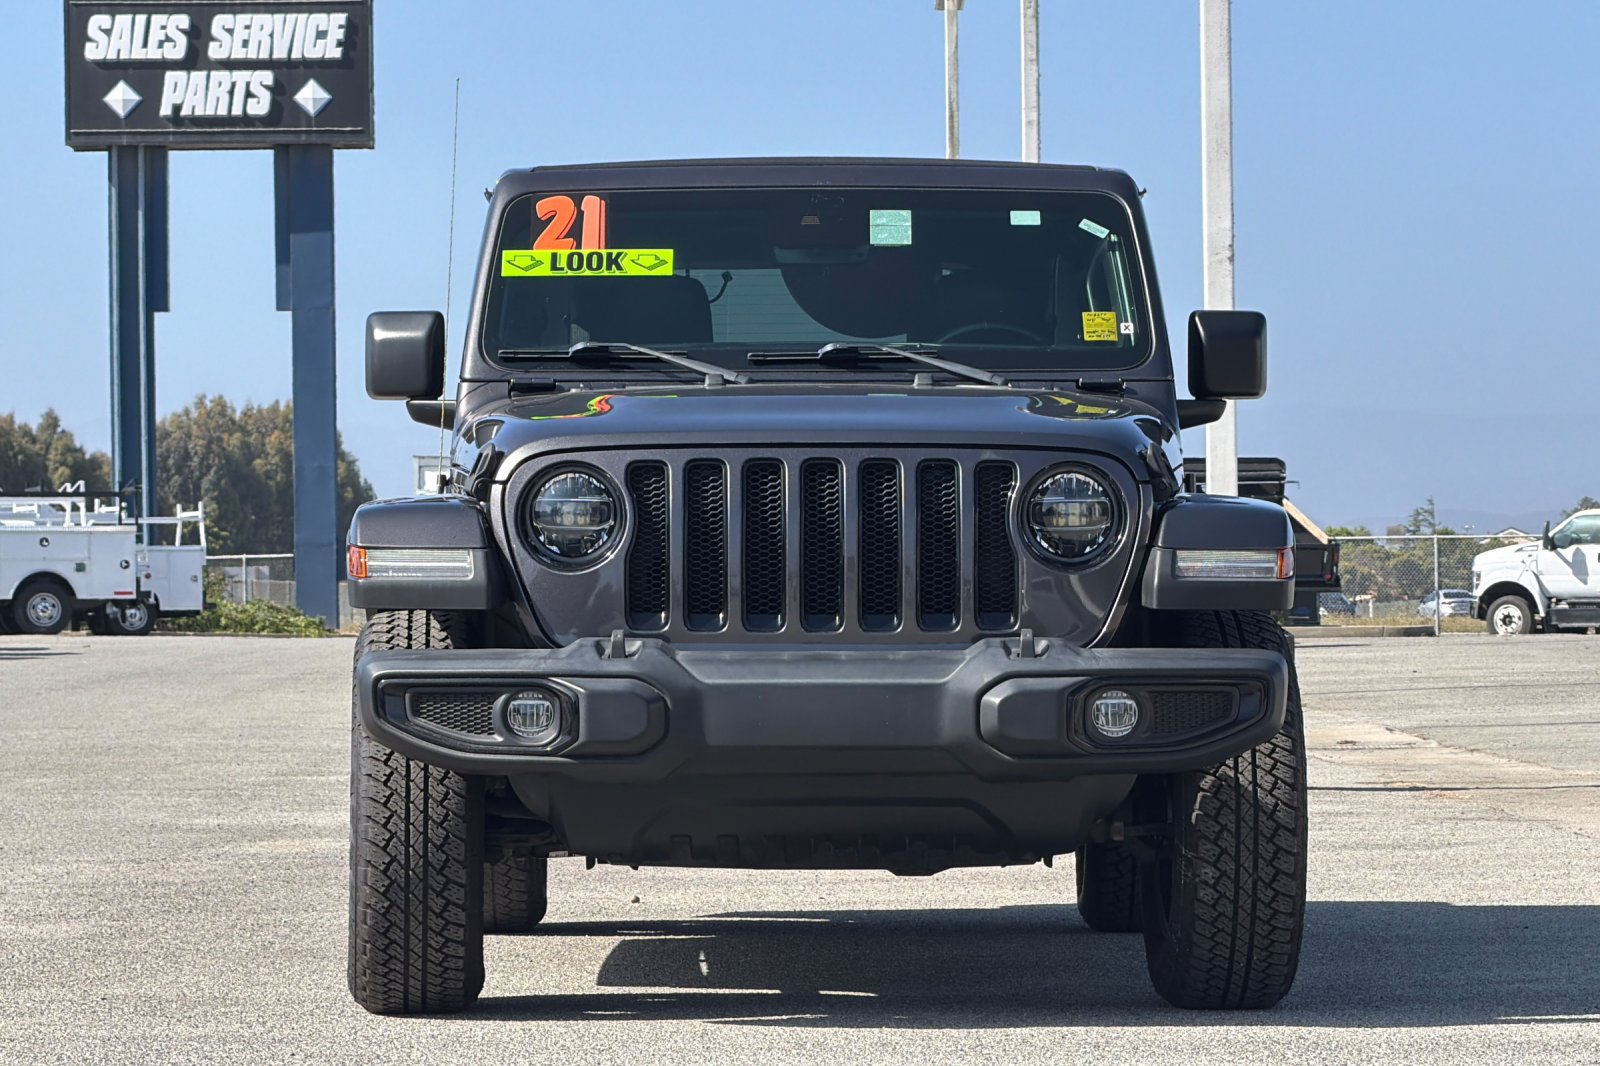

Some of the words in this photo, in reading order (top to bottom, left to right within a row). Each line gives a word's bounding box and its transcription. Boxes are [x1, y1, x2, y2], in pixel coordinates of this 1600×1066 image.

[84, 14, 190, 61] SALES
[207, 13, 348, 60] SERVICE
[159, 70, 274, 118] PARTS
[533, 195, 605, 250] 21
[550, 251, 628, 274] LOOK
